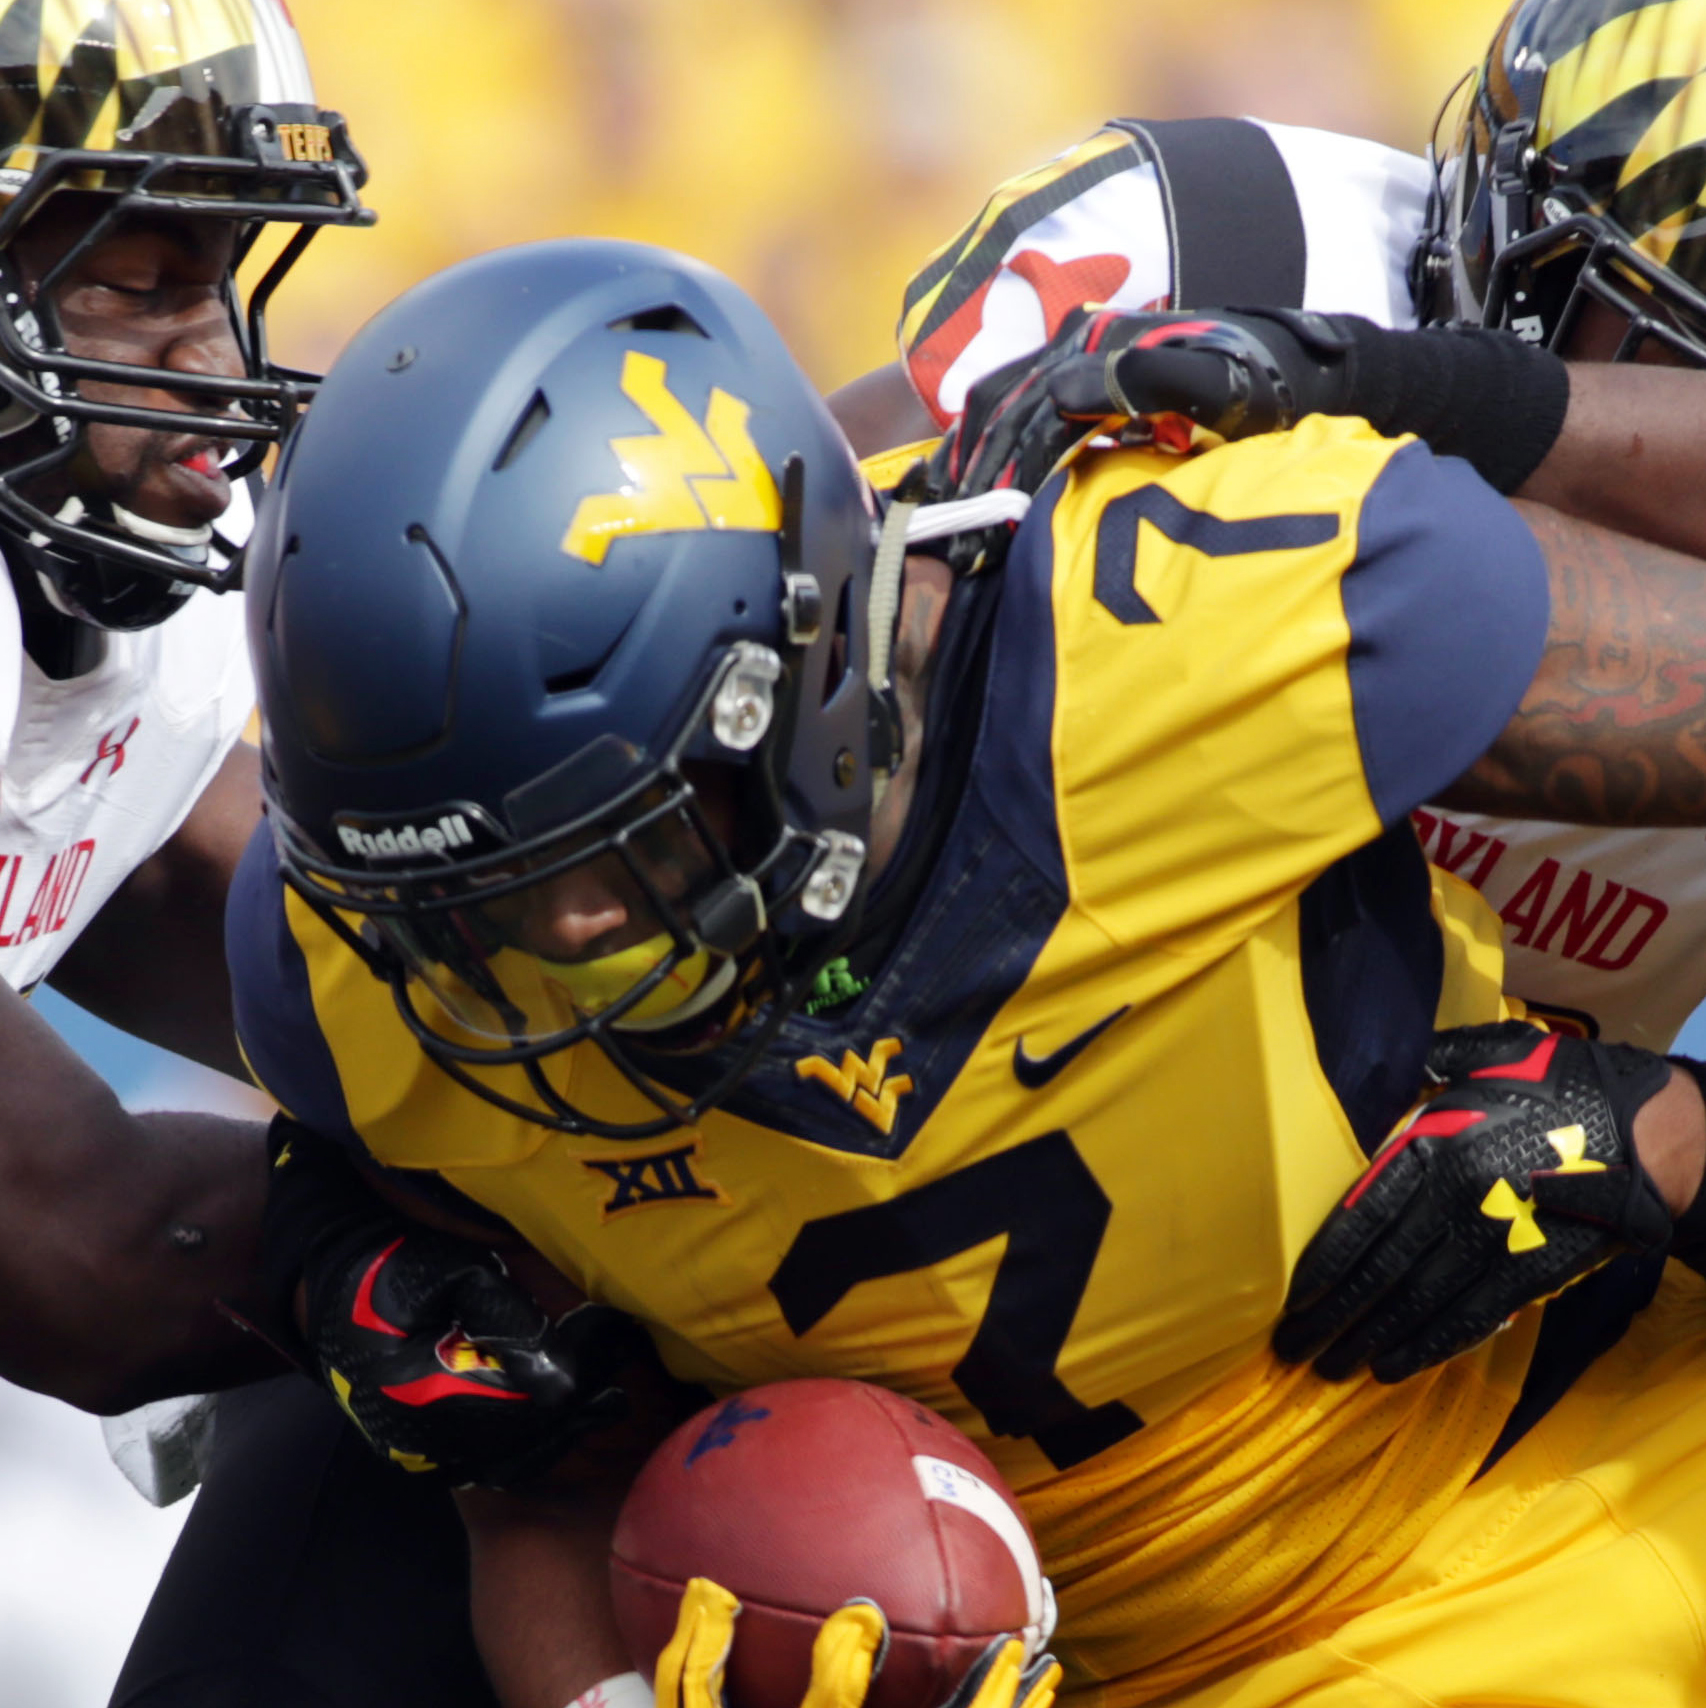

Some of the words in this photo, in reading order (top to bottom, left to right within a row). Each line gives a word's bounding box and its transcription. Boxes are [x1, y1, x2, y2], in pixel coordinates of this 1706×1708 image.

[1094, 484, 1340, 625] 7
[337, 813, 474, 858] Riddell
[767, 1129, 1147, 1472] 7
